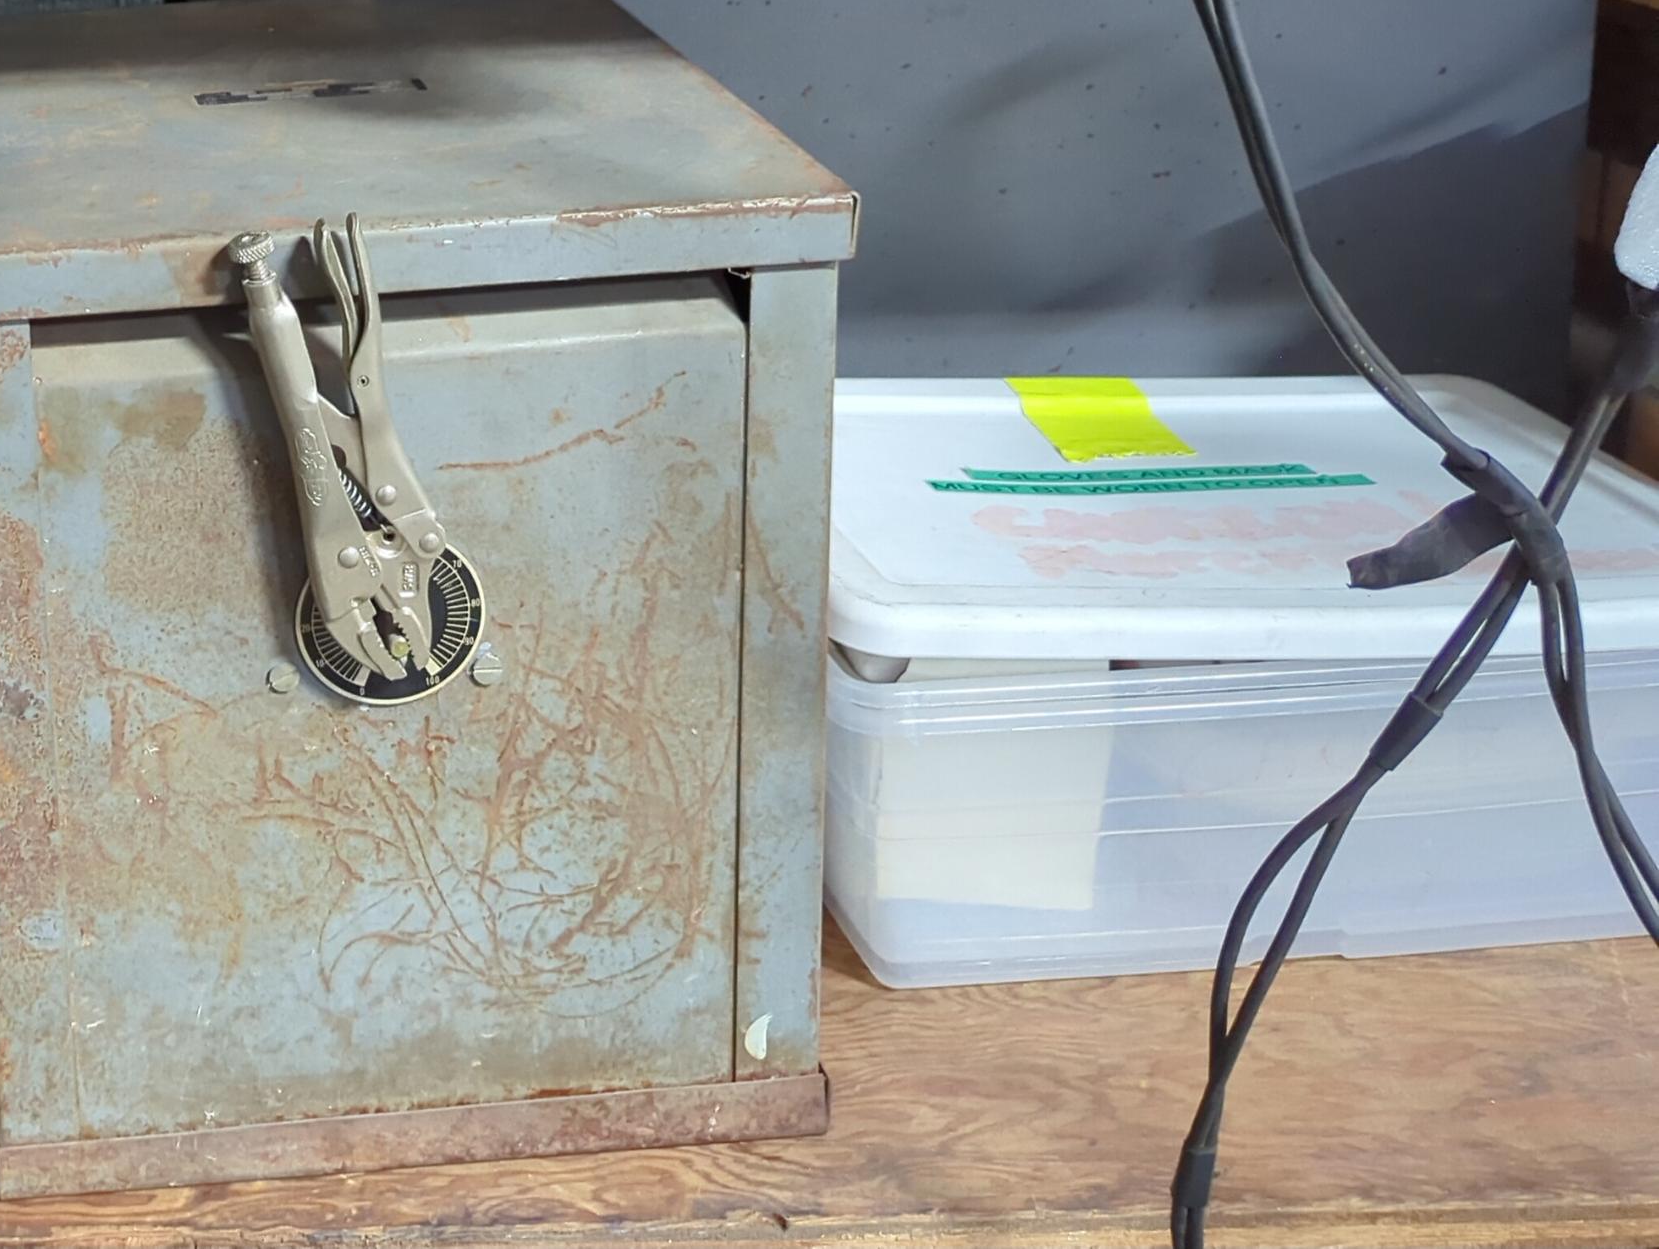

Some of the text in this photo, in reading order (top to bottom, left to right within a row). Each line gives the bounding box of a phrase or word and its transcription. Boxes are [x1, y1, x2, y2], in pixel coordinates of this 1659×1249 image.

[997, 463, 1300, 481] GLOVES AND MASK
[930, 475, 1339, 494] MUST BE WORN TO OPEN
[425, 674, 442, 688] 100
